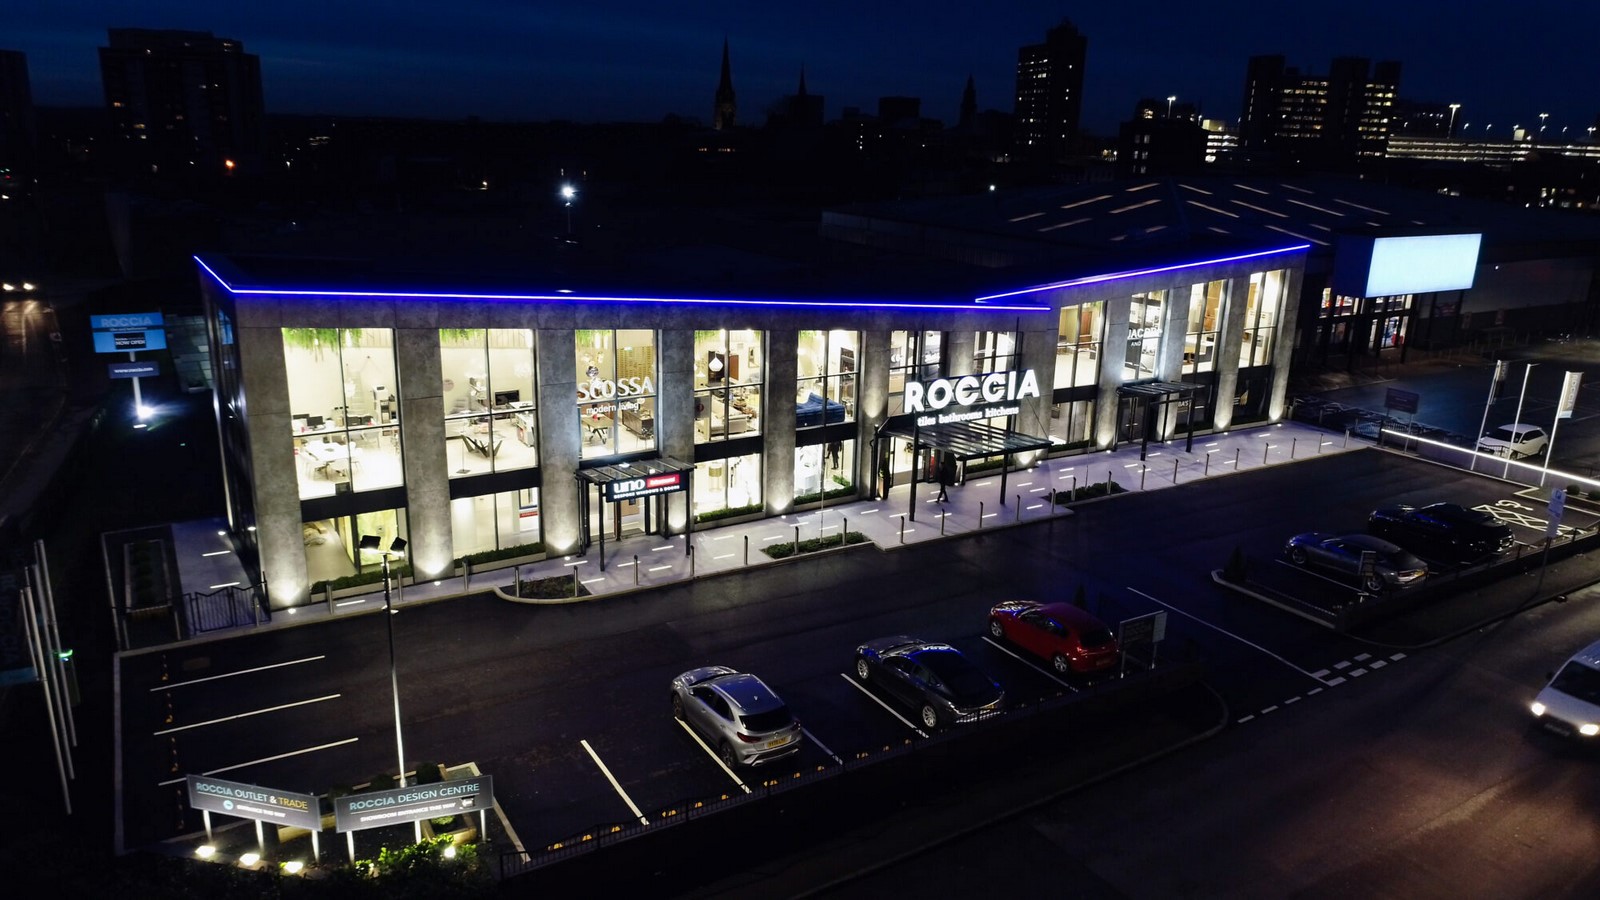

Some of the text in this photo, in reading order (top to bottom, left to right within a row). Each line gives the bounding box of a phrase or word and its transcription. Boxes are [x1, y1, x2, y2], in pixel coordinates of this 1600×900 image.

[100, 316, 152, 327] ROCCIA
[577, 376, 655, 401] SCOSSA
[904, 369, 1040, 413] ROCCIA
[1567, 374, 1579, 411] ROCCIA
[586, 402, 616, 414] modern
[917, 406, 1019, 427] tiles bathrooms kitchens
[613, 479, 646, 494] uno
[196, 782, 308, 809] ROCCIA OUTLET & TRADE
[348, 782, 480, 811] ROCCIA DESIGN CENTRE
